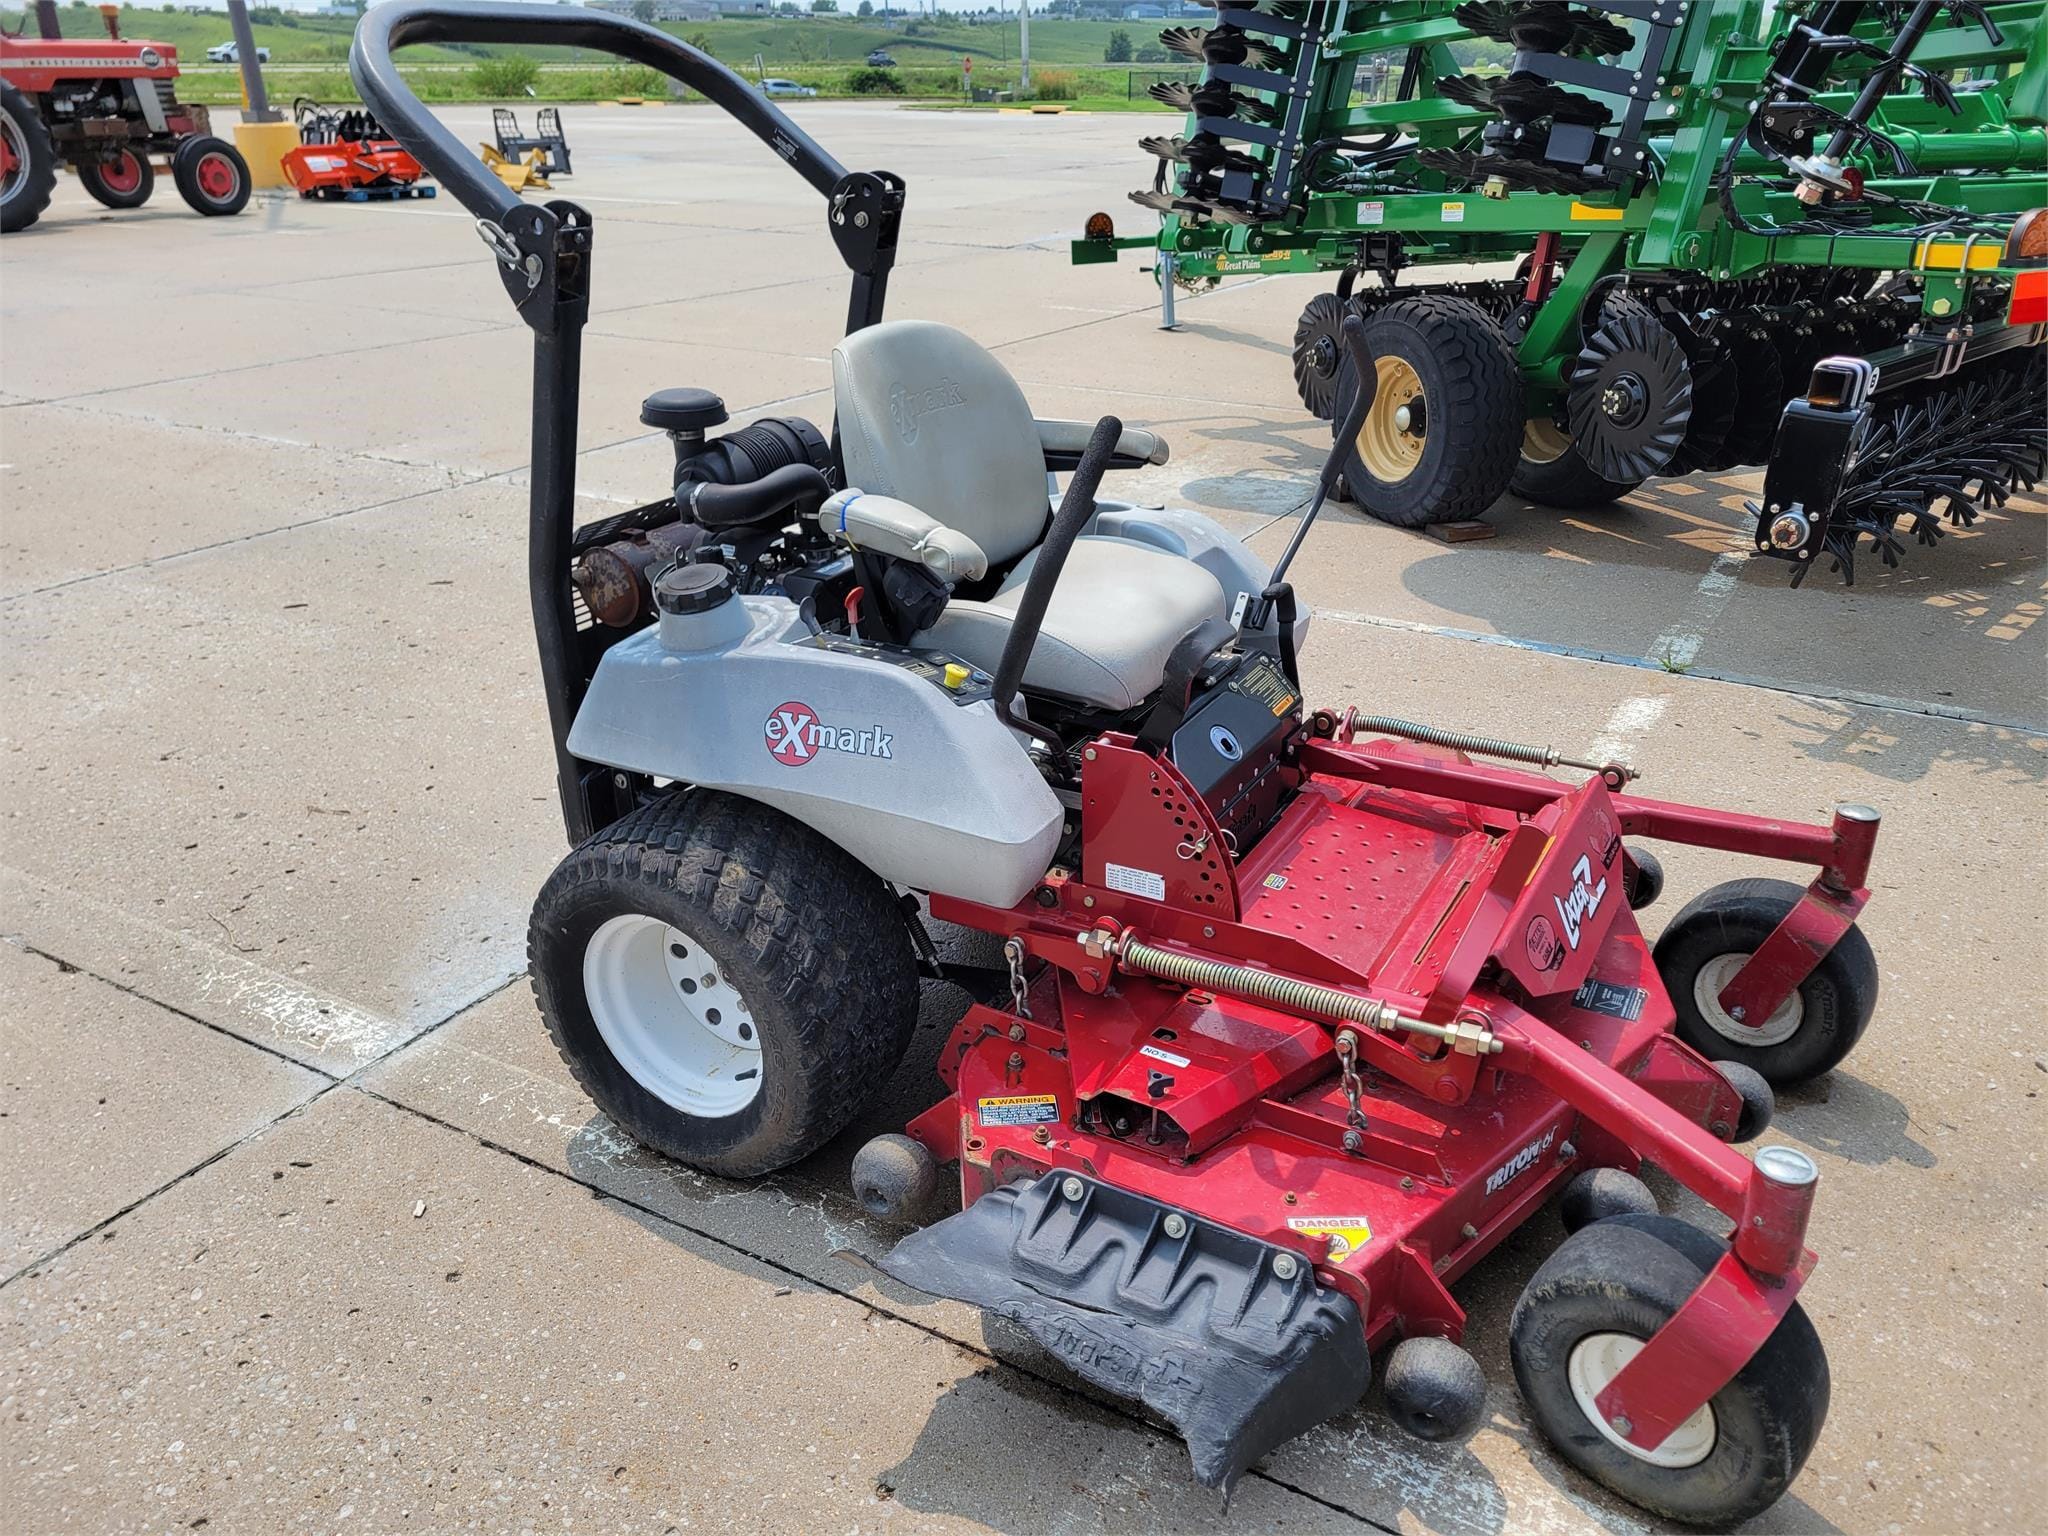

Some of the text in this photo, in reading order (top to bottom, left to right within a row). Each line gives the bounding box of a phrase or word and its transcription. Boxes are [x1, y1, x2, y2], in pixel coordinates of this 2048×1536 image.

[1225, 259, 1261, 271] Great Plains
[1571, 852, 1608, 922] Z
[1553, 880, 1590, 951] LAZER
[1143, 1047, 1159, 1056] NO
[998, 1096, 1050, 1105] WARNING
[1485, 1140, 1541, 1196] TRITON
[1294, 1219, 1361, 1228] DANGER
